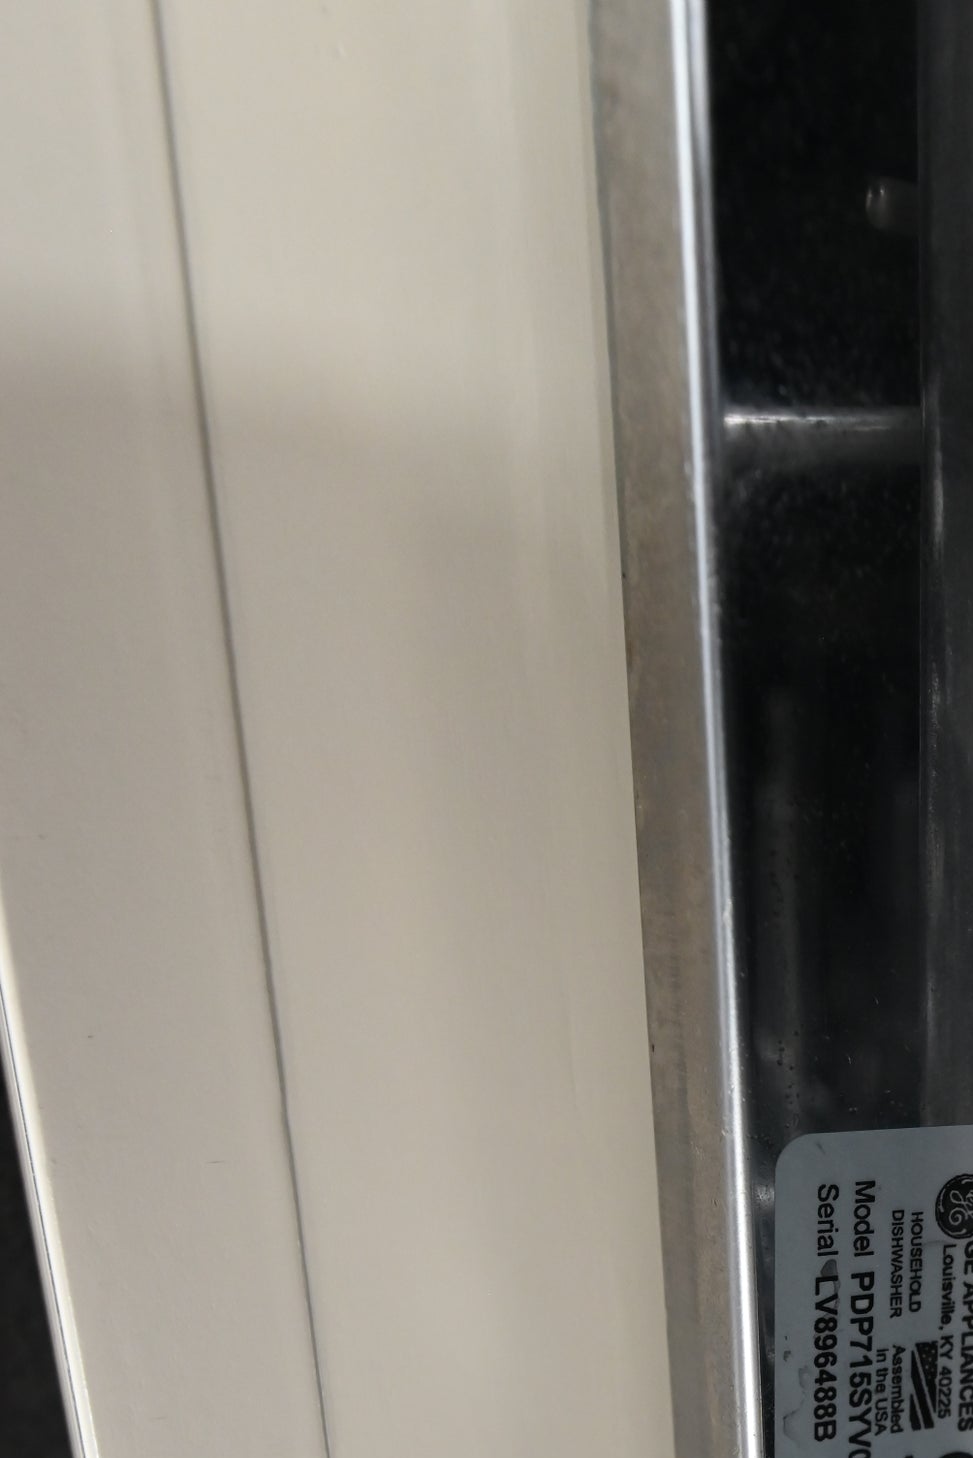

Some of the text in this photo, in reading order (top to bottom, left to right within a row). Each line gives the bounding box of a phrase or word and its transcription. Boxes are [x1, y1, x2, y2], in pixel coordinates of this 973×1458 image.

[854, 1180, 876, 1256] Model
[889, 1209, 905, 1318] DISHWASHER
[908, 1211, 924, 1313] HOUSEHOLD
[813, 1184, 839, 1442] Serial LV896488B
[937, 1244, 957, 1419] Louisville, KY 40225
[874, 1398, 889, 1437] USA
[875, 1368, 889, 1394] the
[890, 1345, 906, 1434] Assembled
